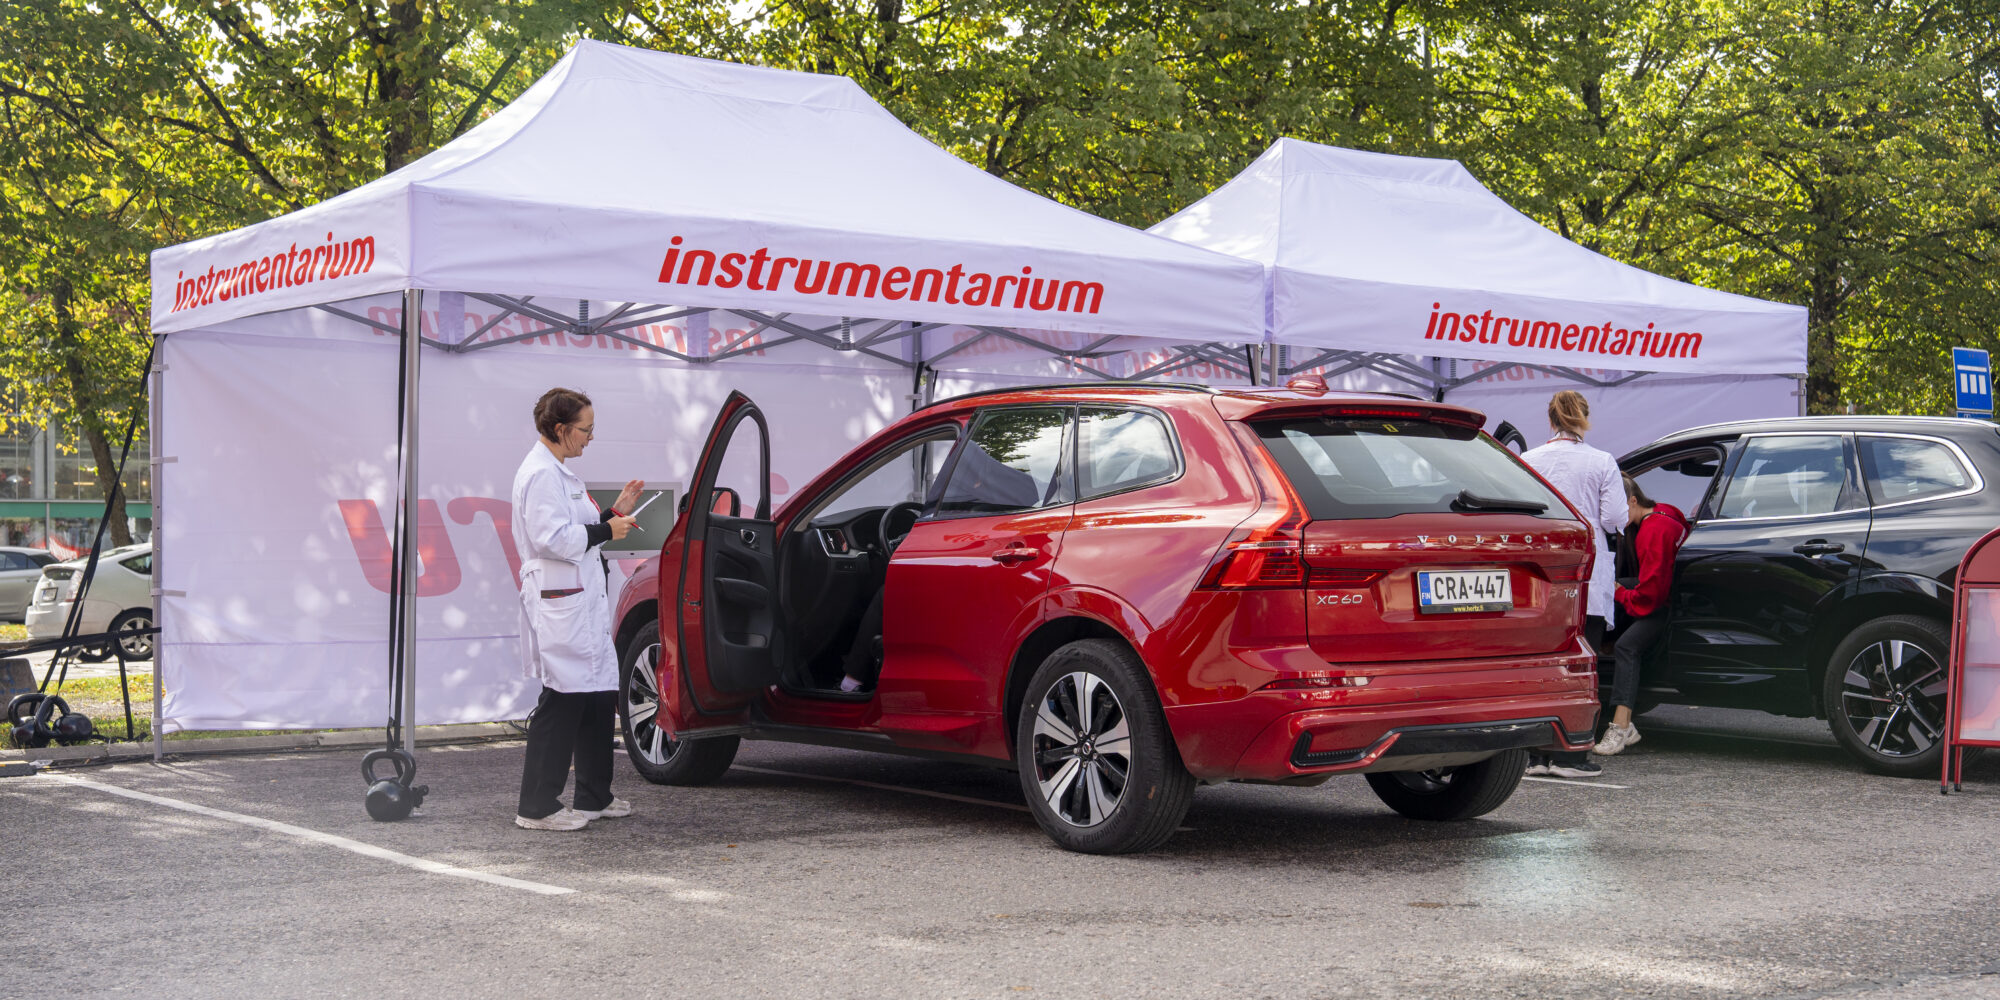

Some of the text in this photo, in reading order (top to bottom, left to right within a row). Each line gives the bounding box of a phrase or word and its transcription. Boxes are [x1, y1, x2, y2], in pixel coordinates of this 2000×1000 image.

[171, 232, 375, 313] instrumentarium
[659, 236, 1105, 314] instrumentarium
[1424, 302, 1703, 358] instrumentarium
[1416, 534, 1533, 544] VOLVO
[1421, 592, 1431, 600] FIN
[1434, 575, 1505, 600] CRA-447
[1453, 605, 1484, 613] www.hertz.fi
